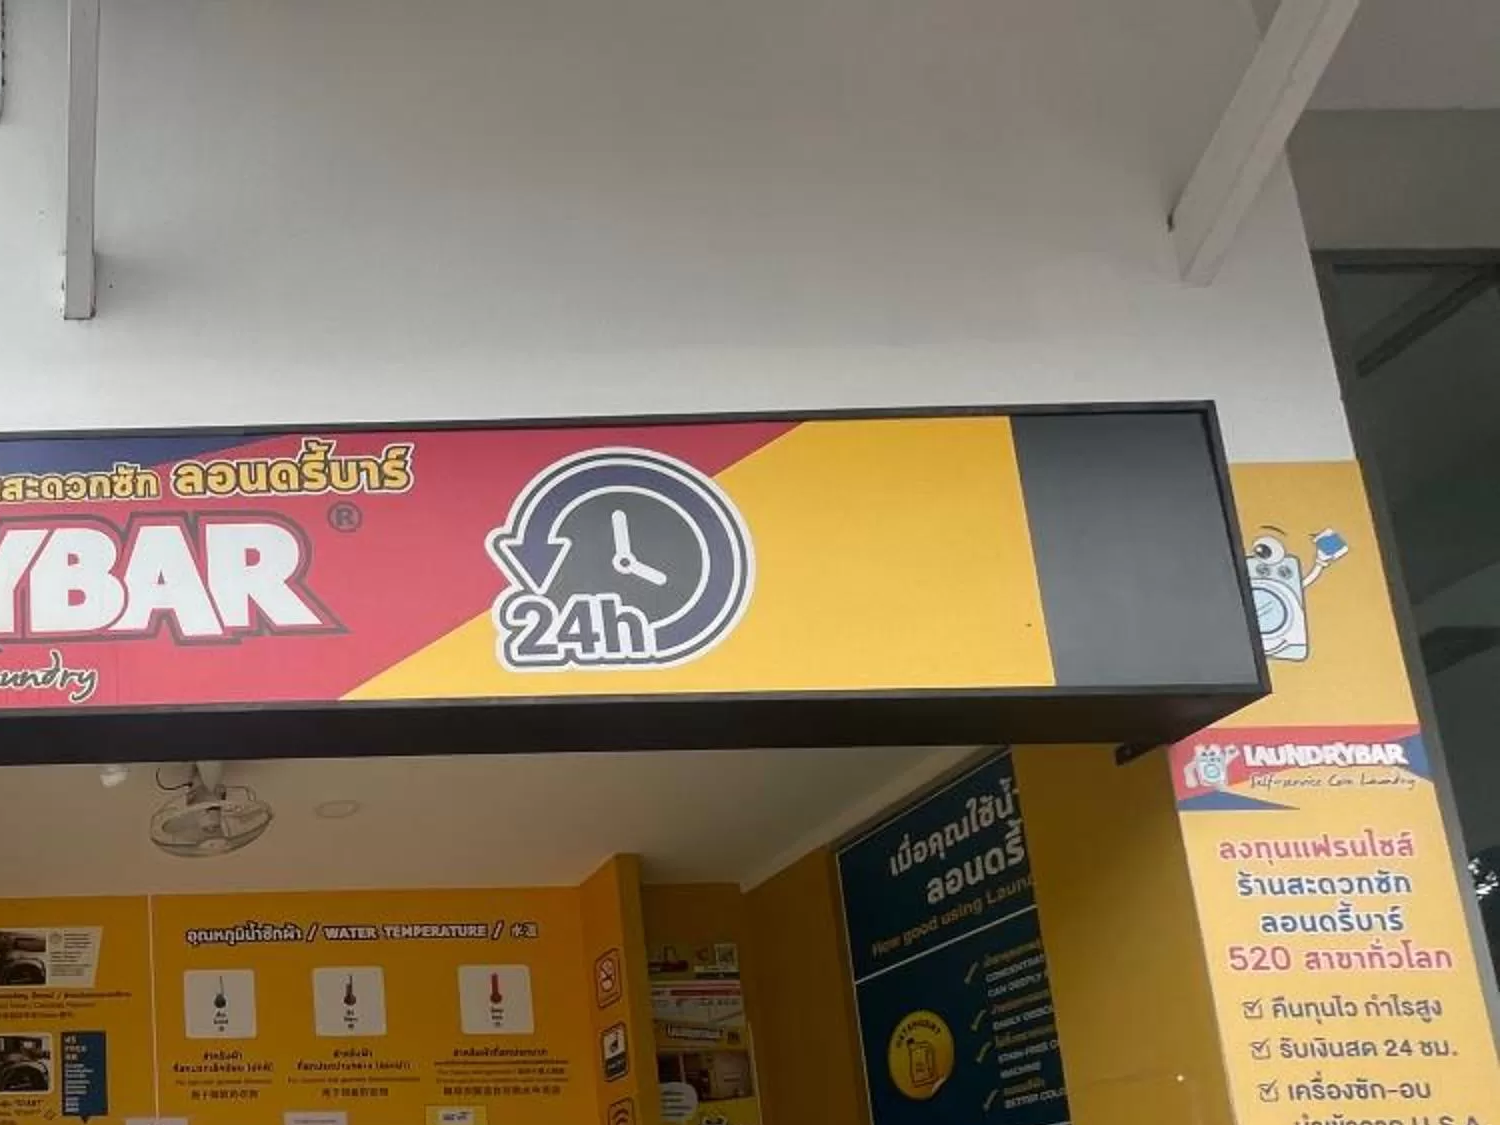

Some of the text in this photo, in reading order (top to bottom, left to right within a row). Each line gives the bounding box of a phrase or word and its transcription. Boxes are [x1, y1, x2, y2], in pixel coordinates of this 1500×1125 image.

[173, 438, 414, 497] ลอนดรี้บาร์
[508, 596, 649, 657] 24h
[1242, 743, 1412, 768] LAUNDRYBAR
[1218, 830, 1415, 865] ลงทุนแฟรนไชส์
[1236, 870, 1412, 897] ร้านสะดวกซัก
[324, 926, 377, 940] WATER
[384, 925, 487, 939] TEMPERATURE
[1260, 901, 1405, 934] ลอนดรี้บาร์
[1227, 938, 1453, 971] 520 สาขาทั่วโลก
[1271, 993, 1442, 1025] คืนทุนไว กำไรสูง
[1279, 1036, 1458, 1060] รับเงินสด 24 ชม.
